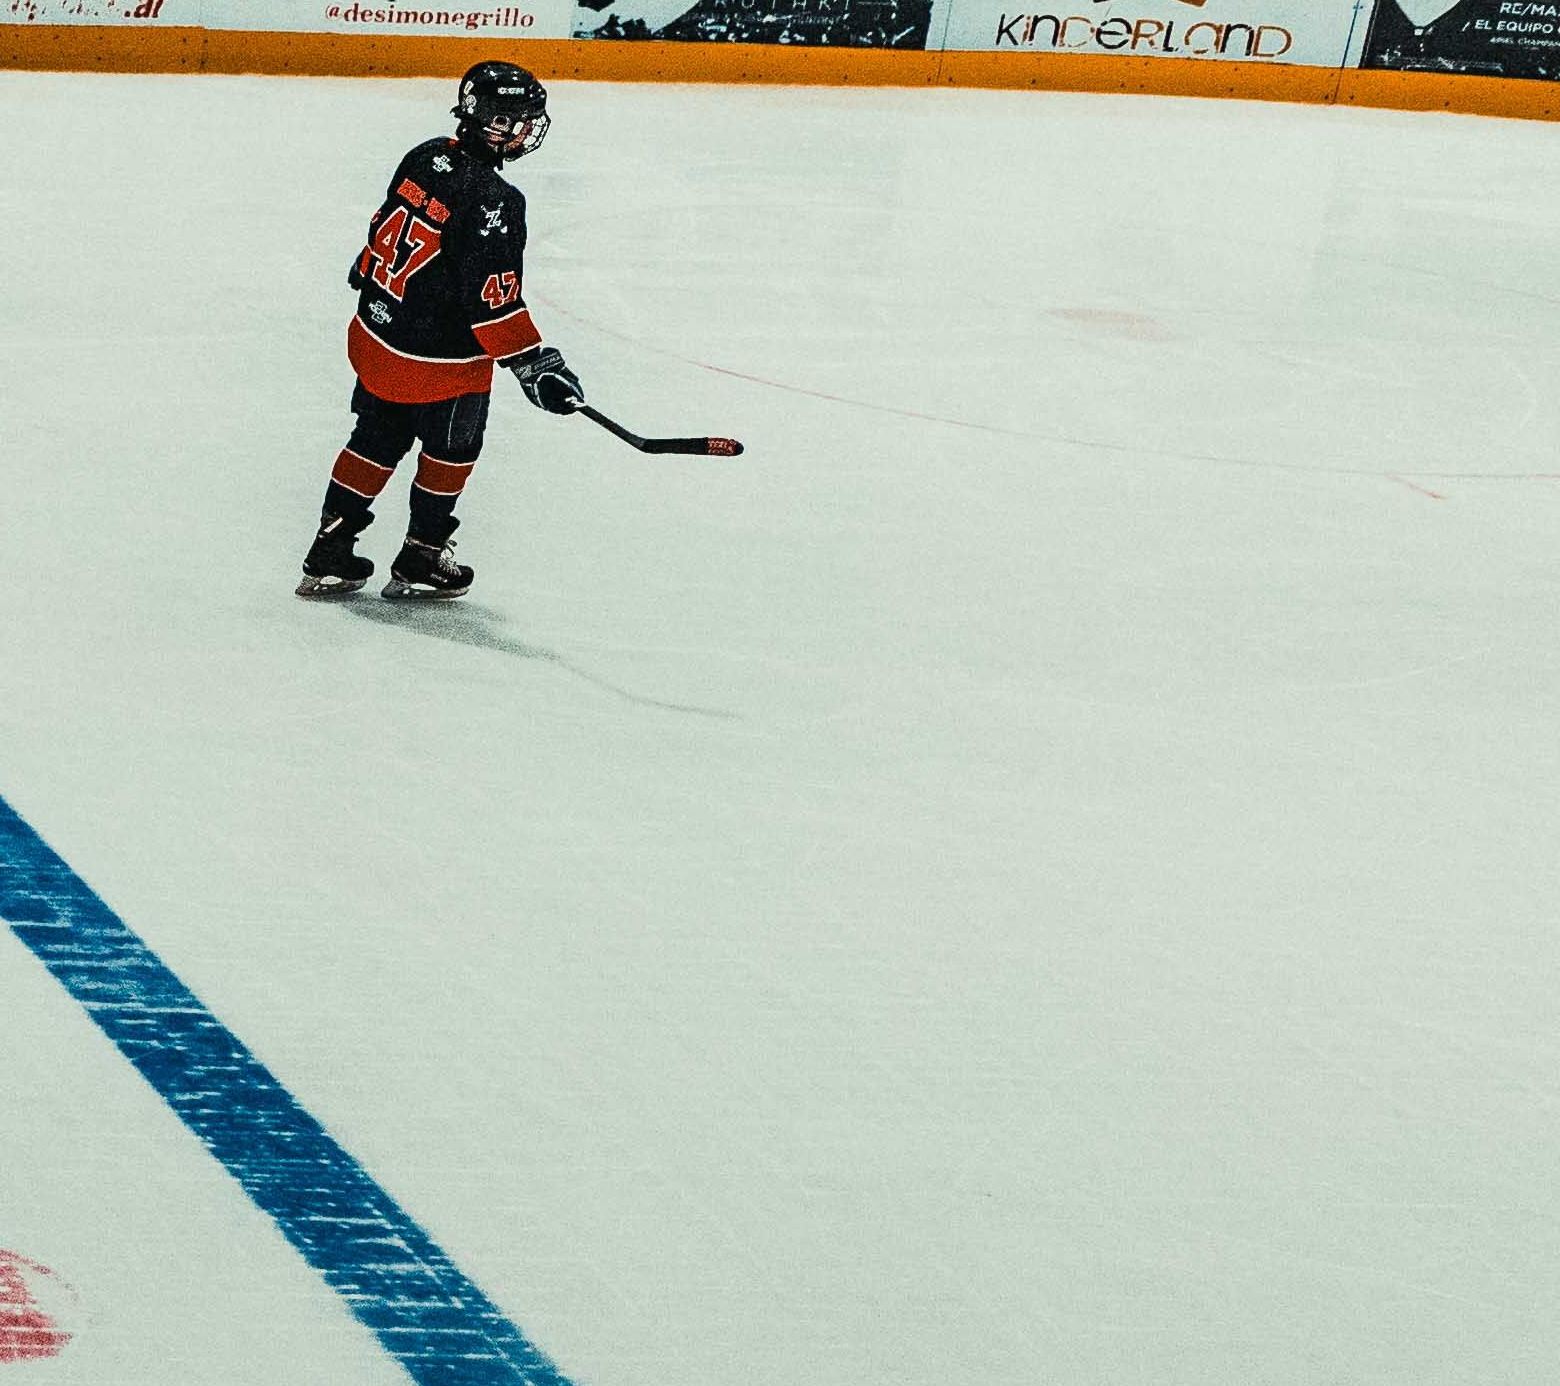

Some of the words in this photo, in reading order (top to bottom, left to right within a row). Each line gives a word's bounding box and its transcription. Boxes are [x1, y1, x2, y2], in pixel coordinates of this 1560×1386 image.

[1475, 19, 1492, 30] EL
[1496, 20, 1554, 34] EQUIPO
[370, 205, 442, 304] 47
[480, 270, 520, 310] 47
